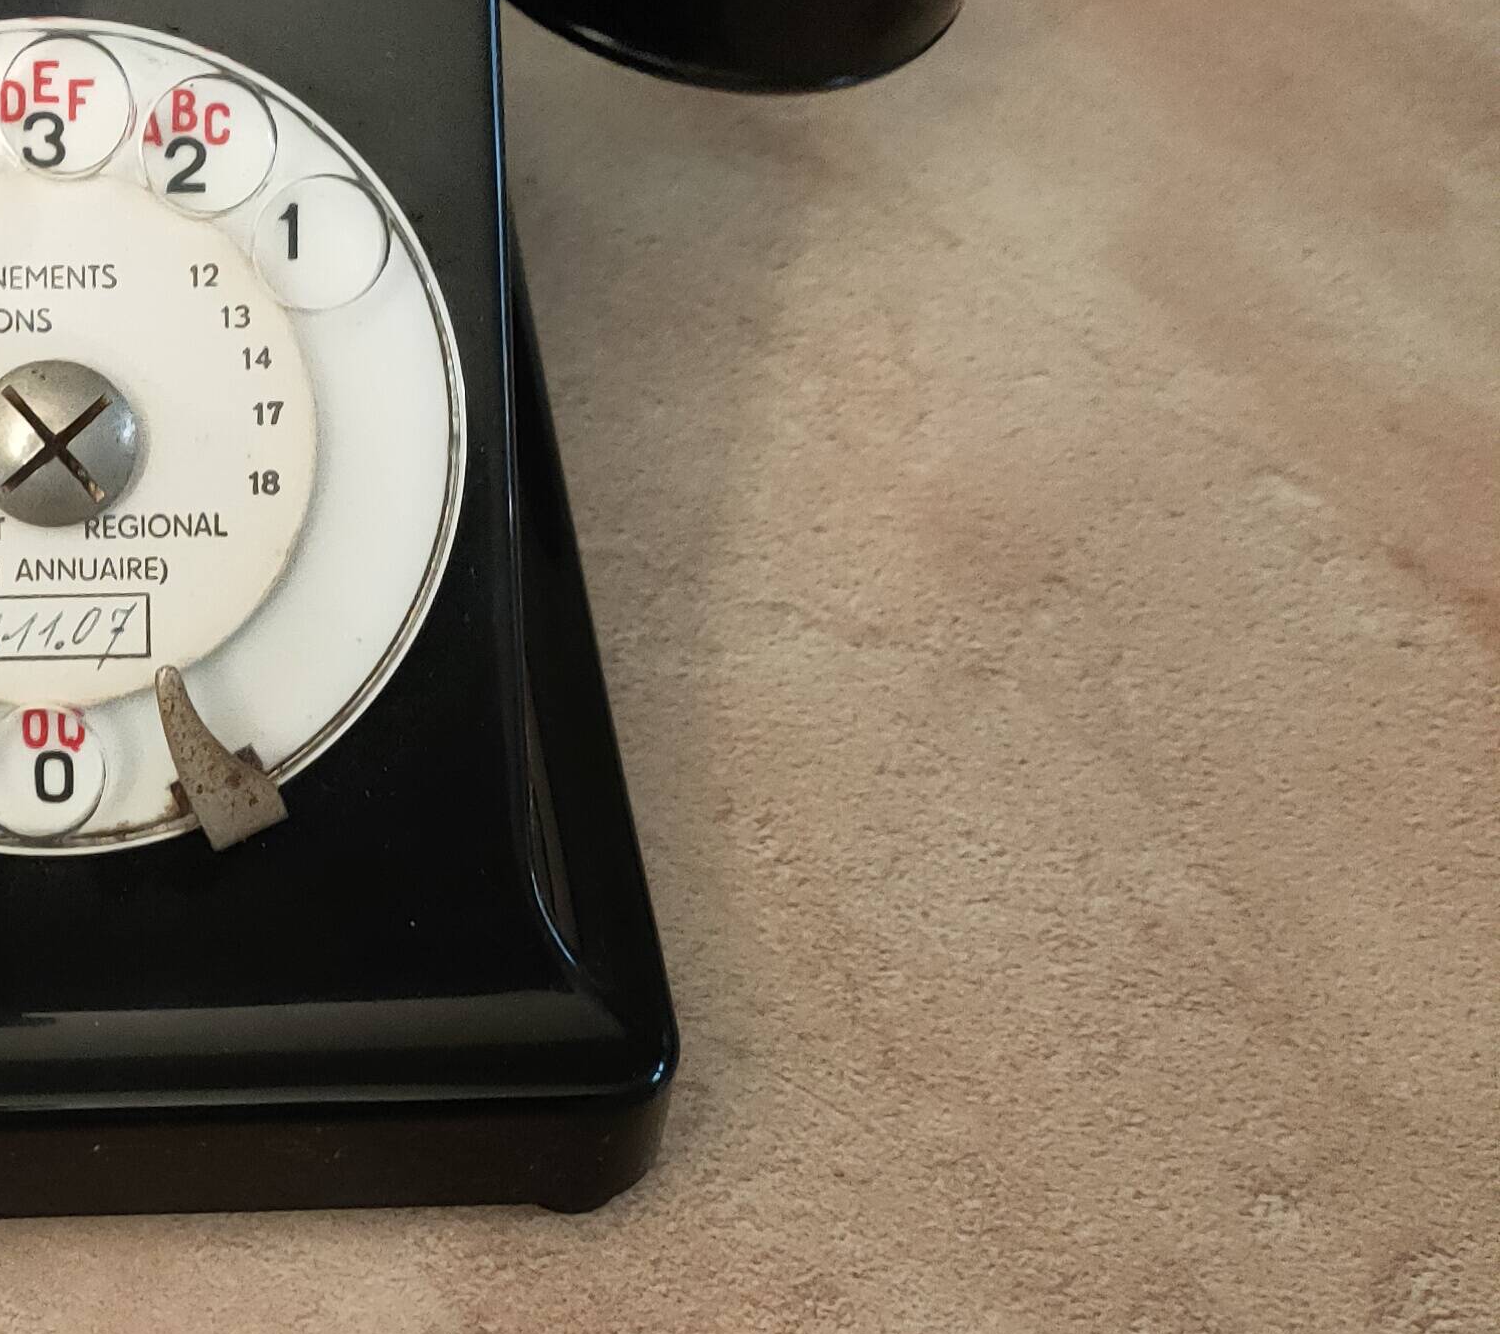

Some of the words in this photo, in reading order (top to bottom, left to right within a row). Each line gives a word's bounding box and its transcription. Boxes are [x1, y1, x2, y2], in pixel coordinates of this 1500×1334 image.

[0, 60, 94, 122] DEF
[22, 111, 66, 167] 3
[164, 136, 207, 194] 2
[278, 203, 299, 260] 1
[189, 263, 219, 288] 12
[220, 304, 250, 328] 13
[242, 346, 272, 370] 14
[252, 401, 284, 426] 17
[248, 470, 280, 496] 18
[84, 512, 228, 540] REGIONAL
[15, 556, 169, 585] ANNUAIRE)
